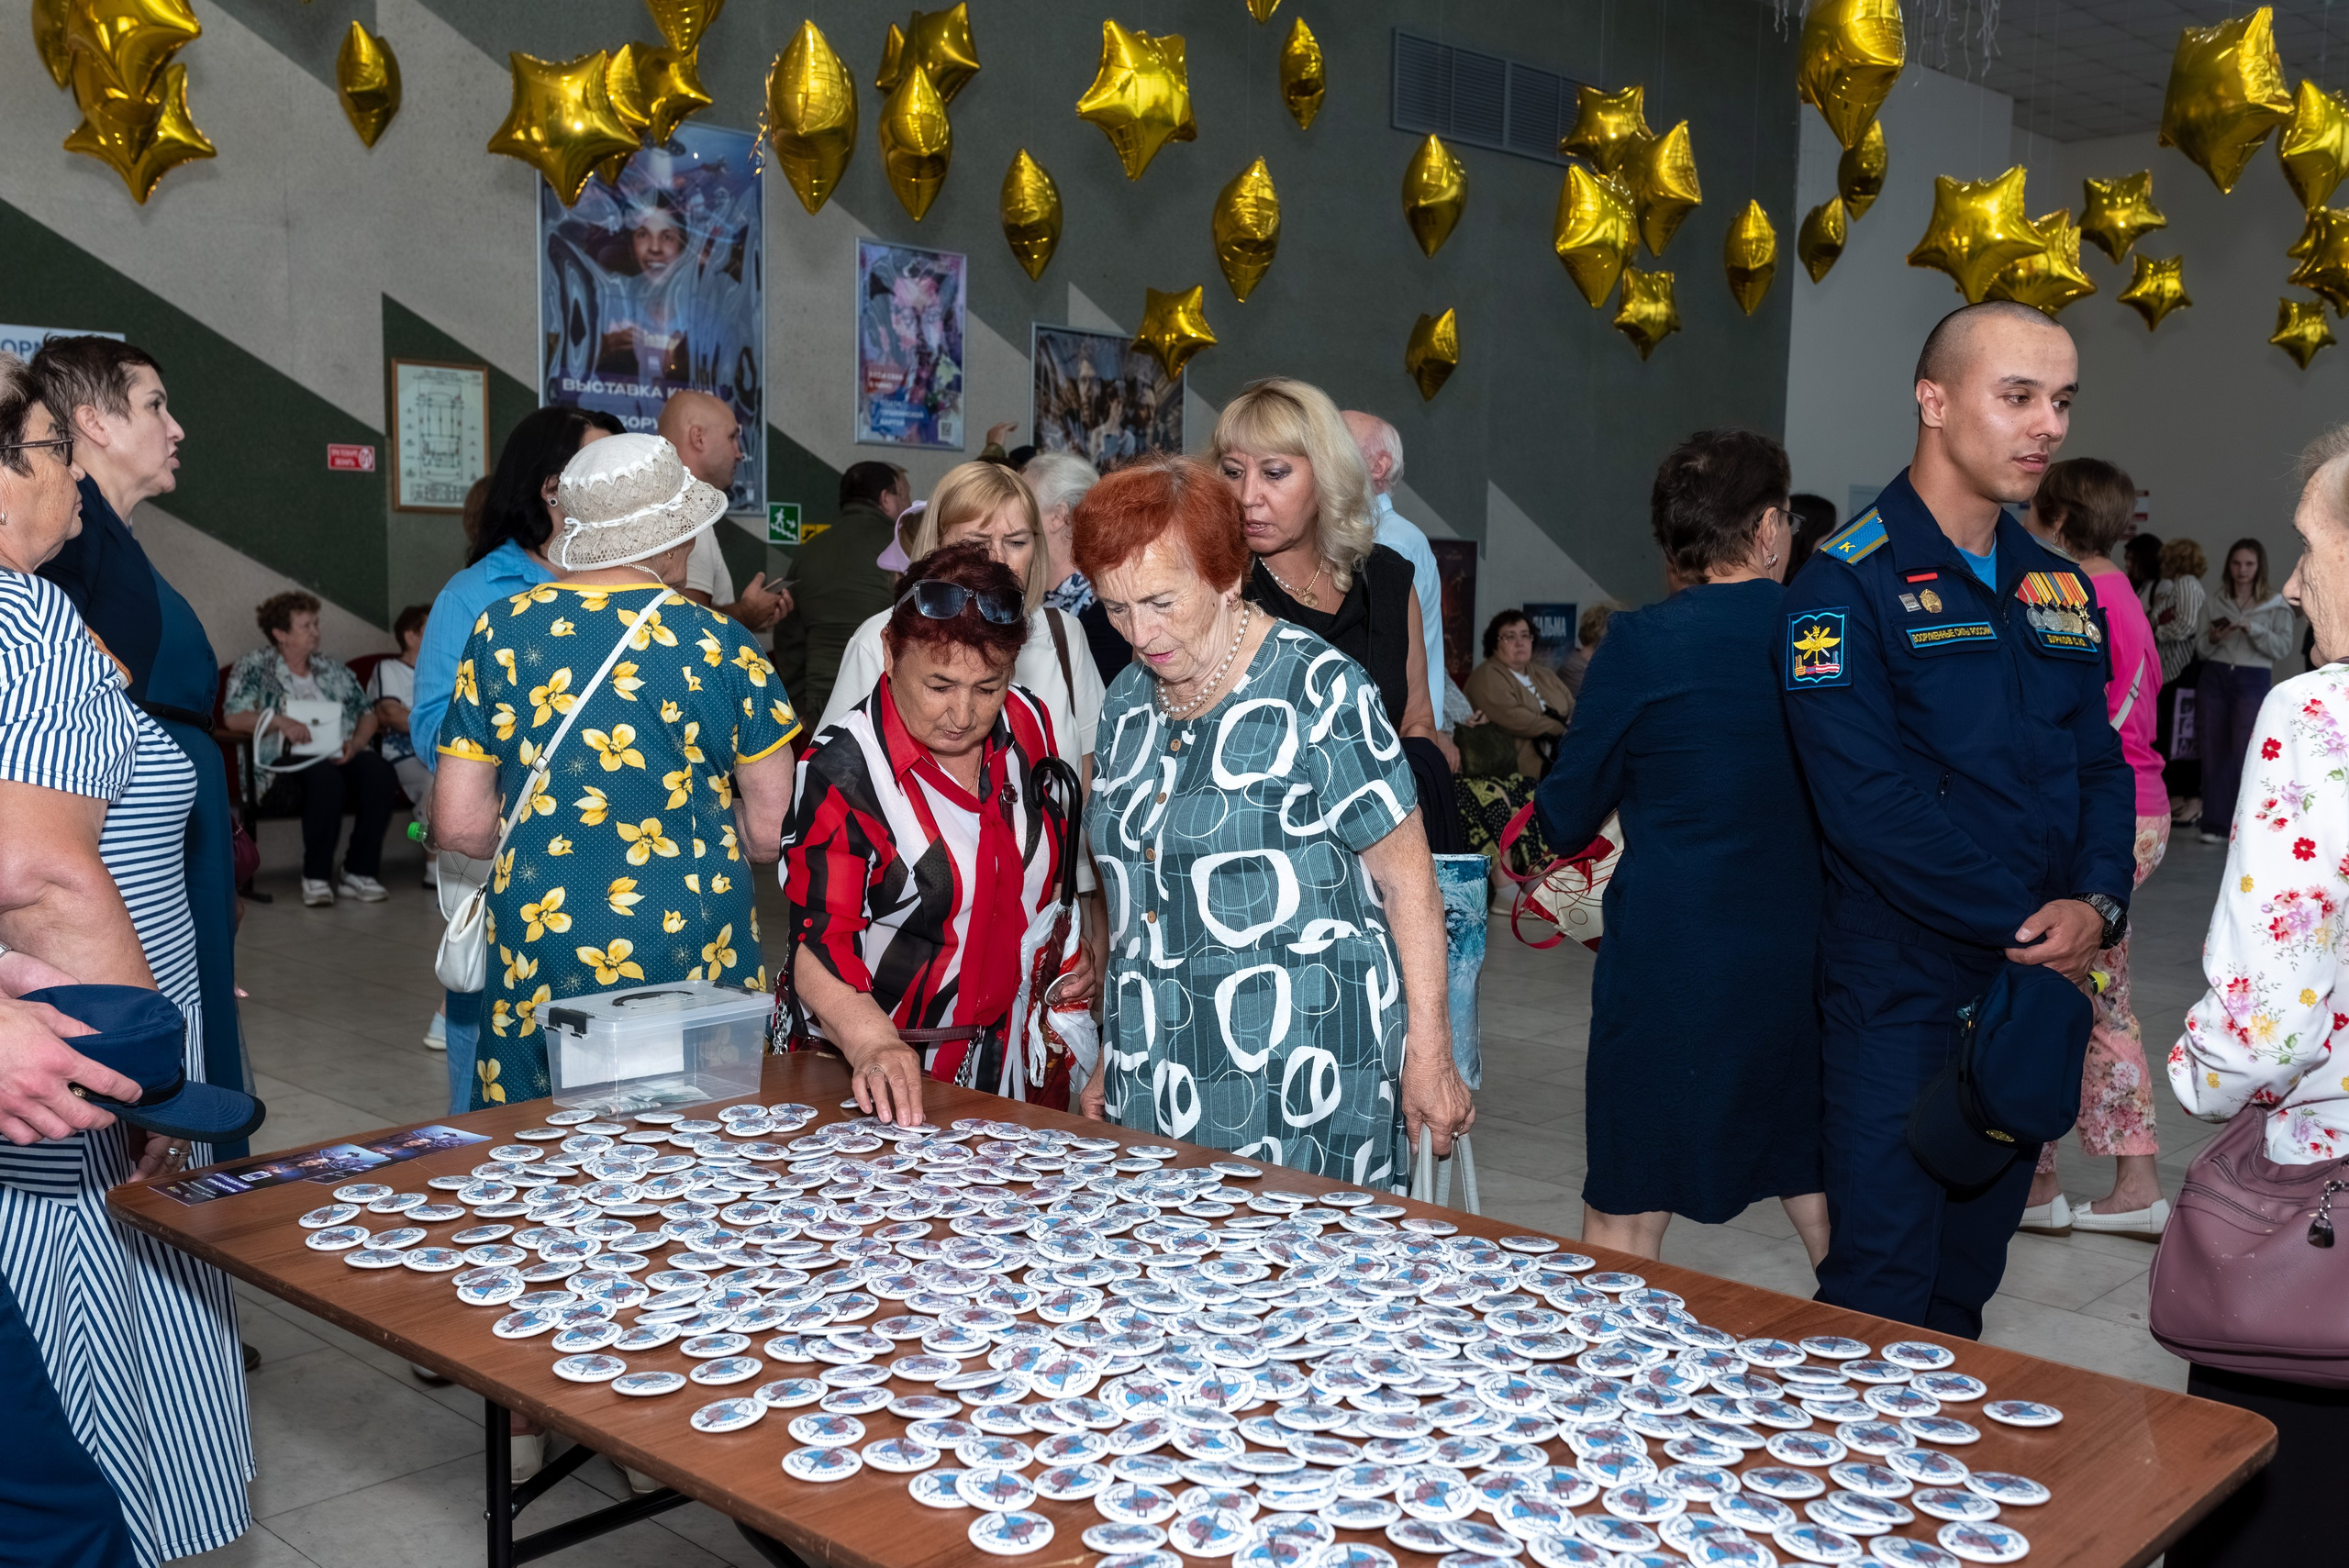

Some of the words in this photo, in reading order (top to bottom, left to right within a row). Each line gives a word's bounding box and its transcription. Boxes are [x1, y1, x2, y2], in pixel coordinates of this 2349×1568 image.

[562, 377, 663, 398] ВЫСТАВКА
[1911, 628, 1955, 642] ВООРУЖЕННЫЕ
[1954, 628, 1971, 638] СИЛЫ
[1969, 627, 1992, 636] РОССИИ
[2046, 634, 2074, 645] БУРКОВ
